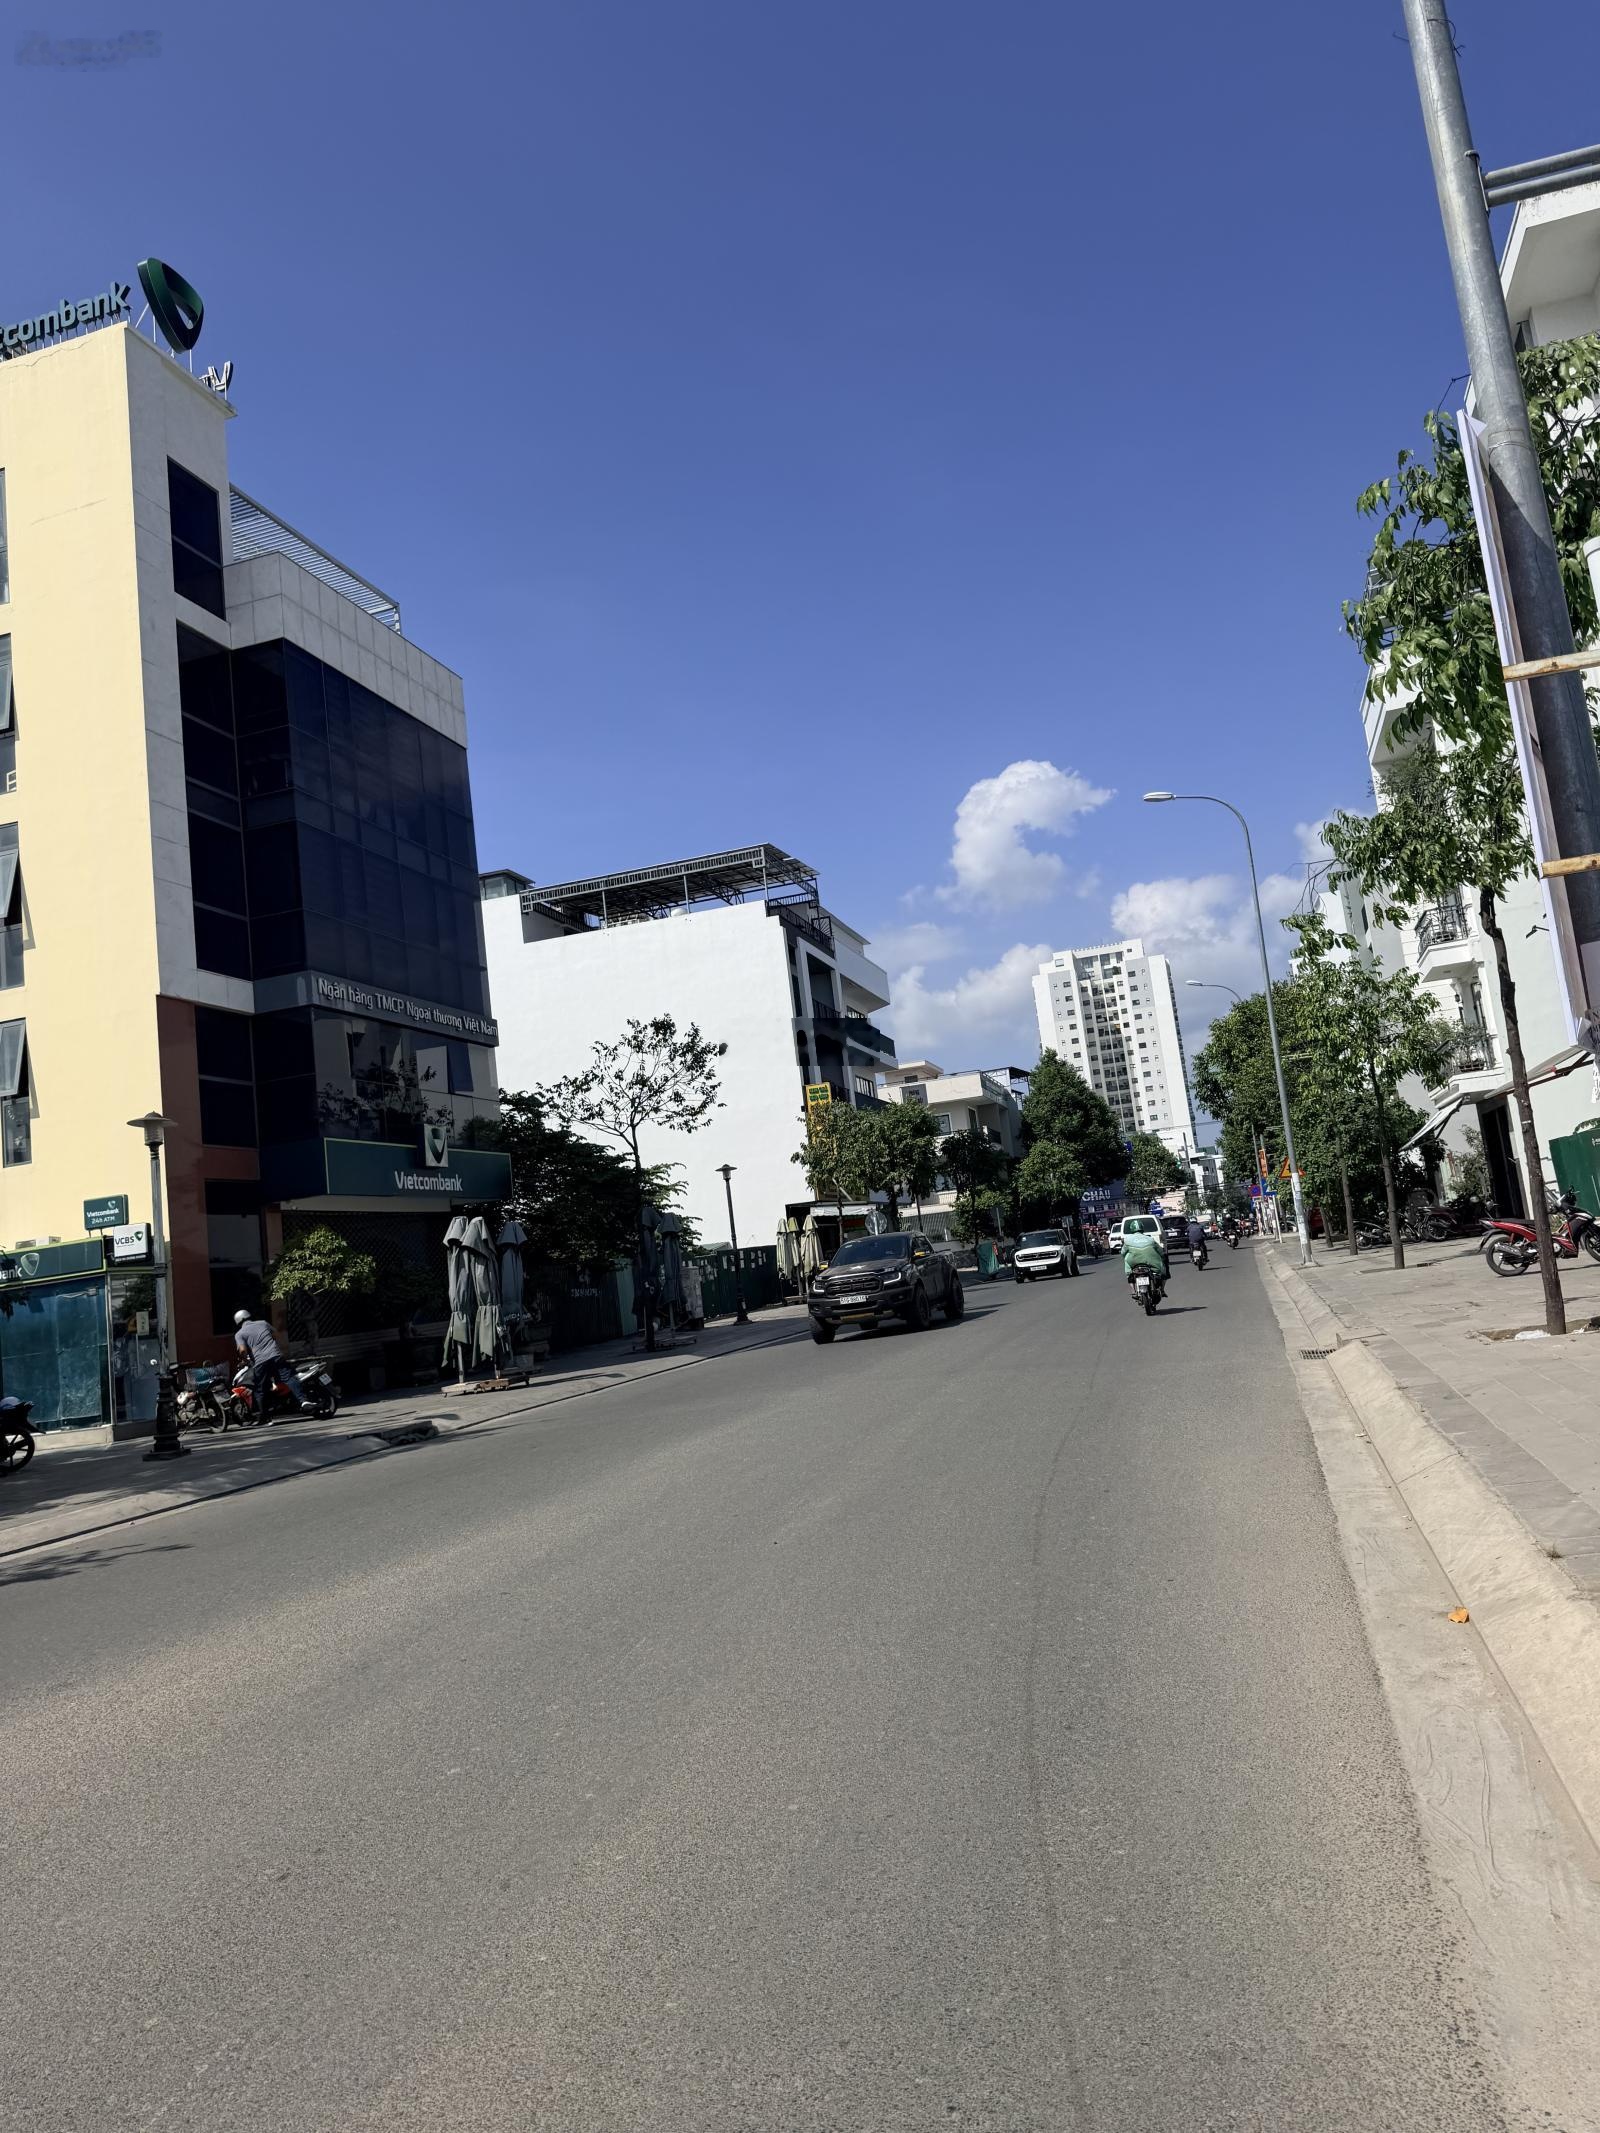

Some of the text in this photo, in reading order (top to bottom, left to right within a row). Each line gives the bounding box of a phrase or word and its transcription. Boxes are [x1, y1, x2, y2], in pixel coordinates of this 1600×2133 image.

[318, 977, 498, 1036] Ngân hàng TMCP Ngoại thương Việt Nam
[394, 1170, 463, 1191] Vietcombank
[1082, 1187, 1111, 1202] CHÂU
[114, 1235, 135, 1246] VCBS
